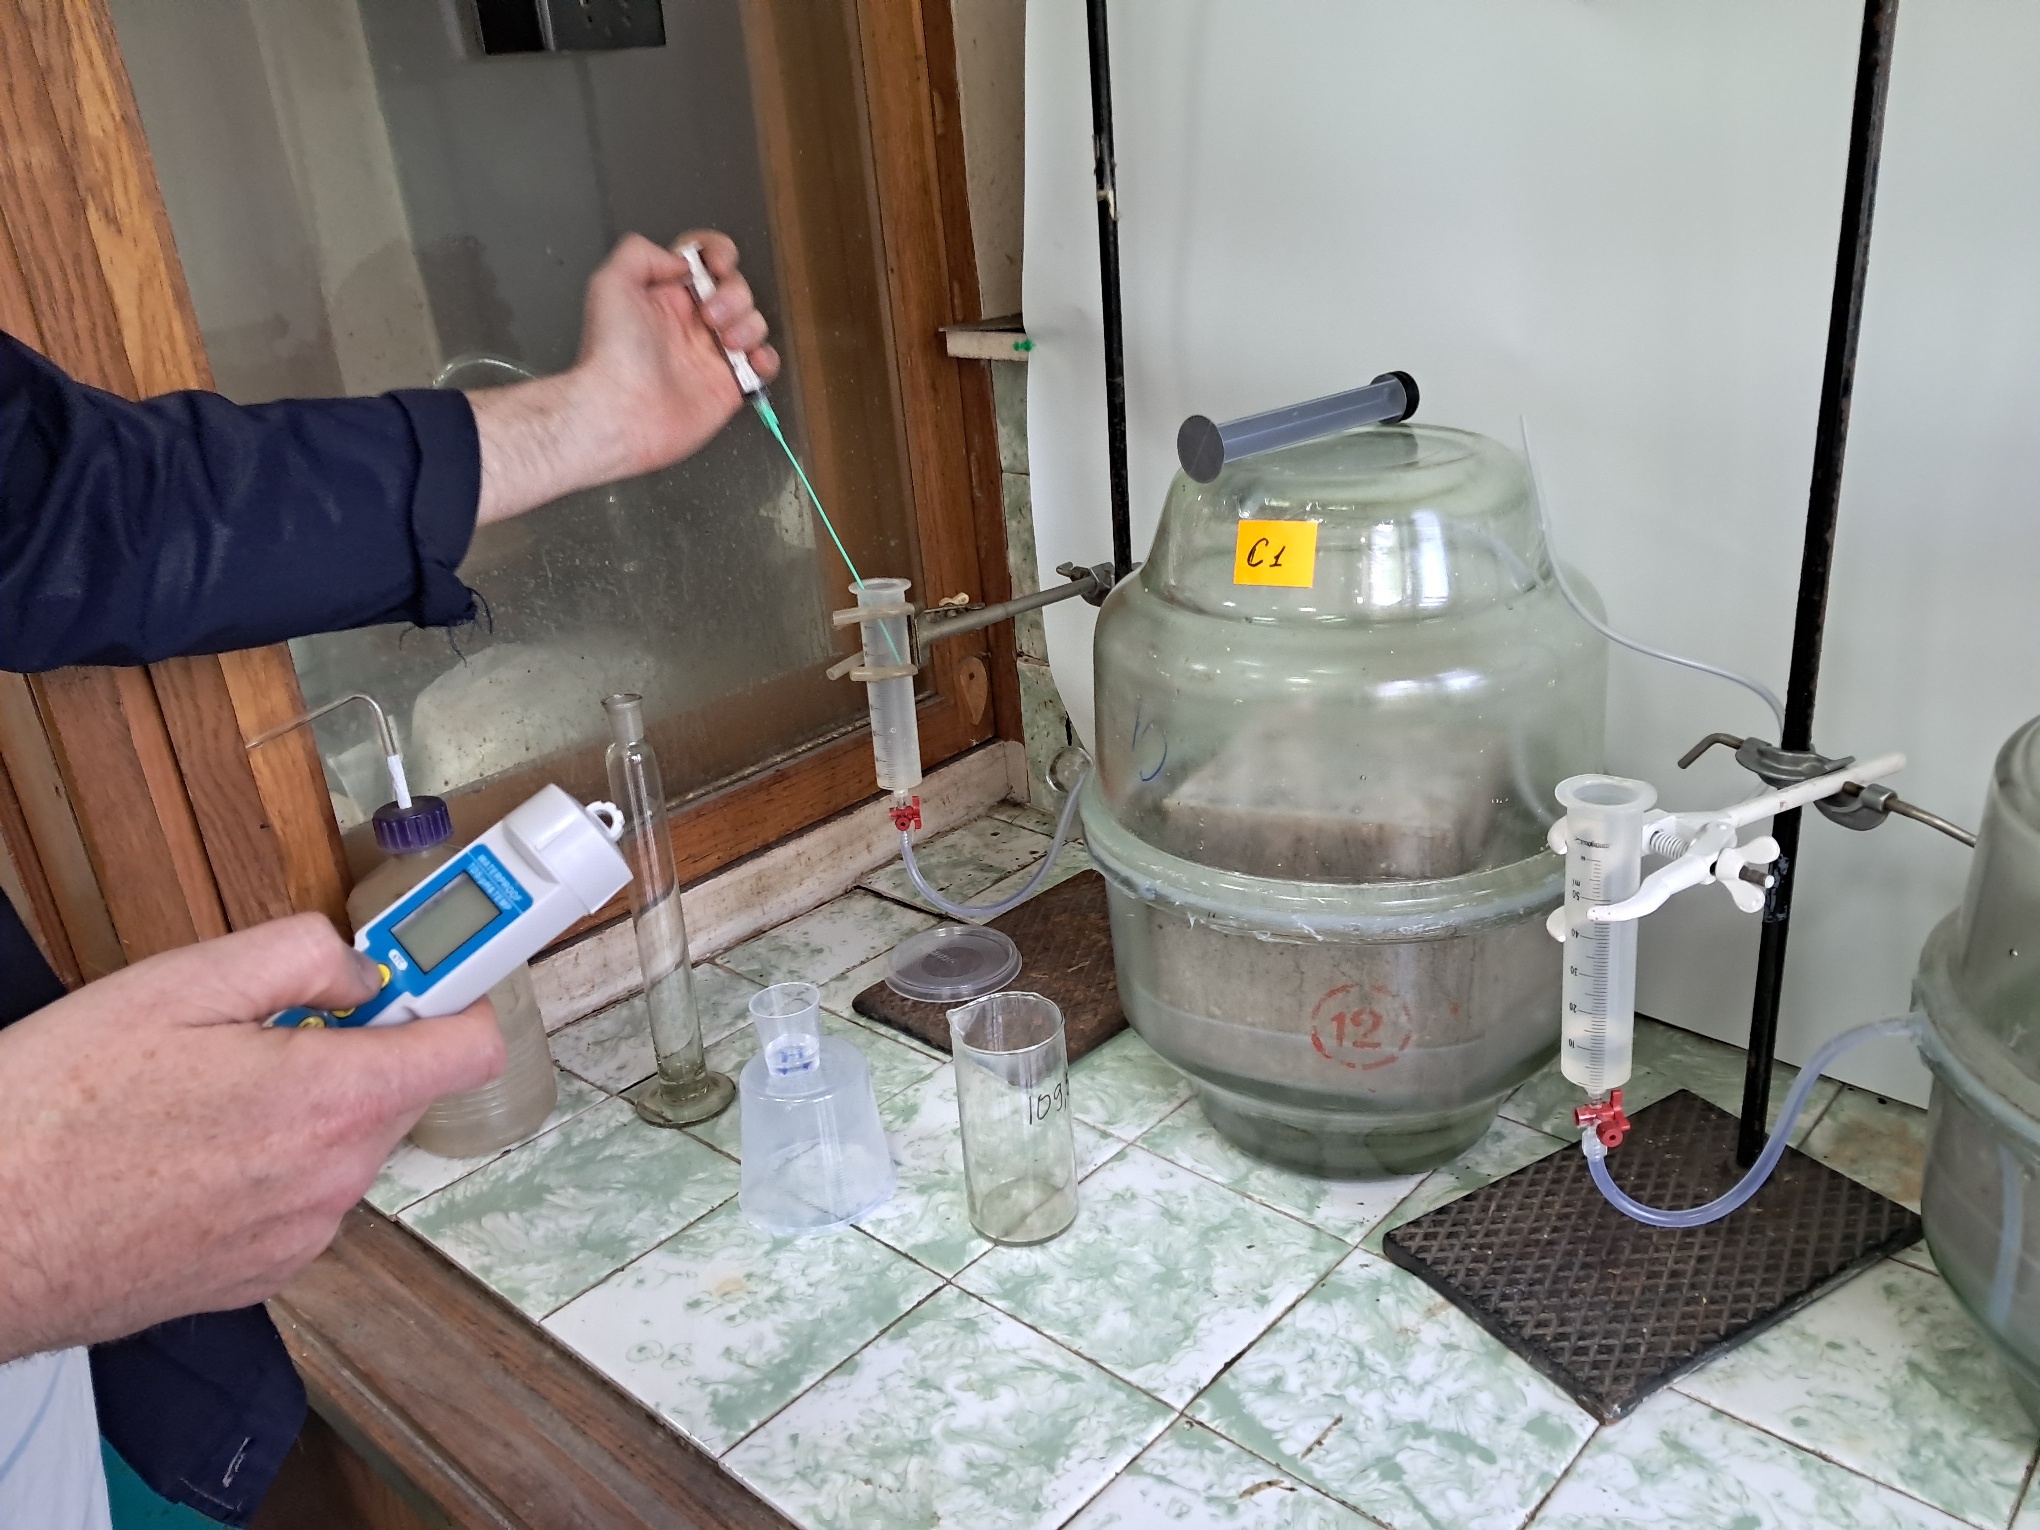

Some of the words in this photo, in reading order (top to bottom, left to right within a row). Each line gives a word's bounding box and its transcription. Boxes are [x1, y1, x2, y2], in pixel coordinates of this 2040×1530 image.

[1247, 537, 1286, 568] C1
[1572, 890, 1580, 901] 50
[1571, 928, 1580, 939] 40
[1570, 965, 1578, 976] 30
[1569, 1002, 1577, 1013] 20
[1331, 1008, 1383, 1049] 12
[1568, 1039, 1575, 1049] 10
